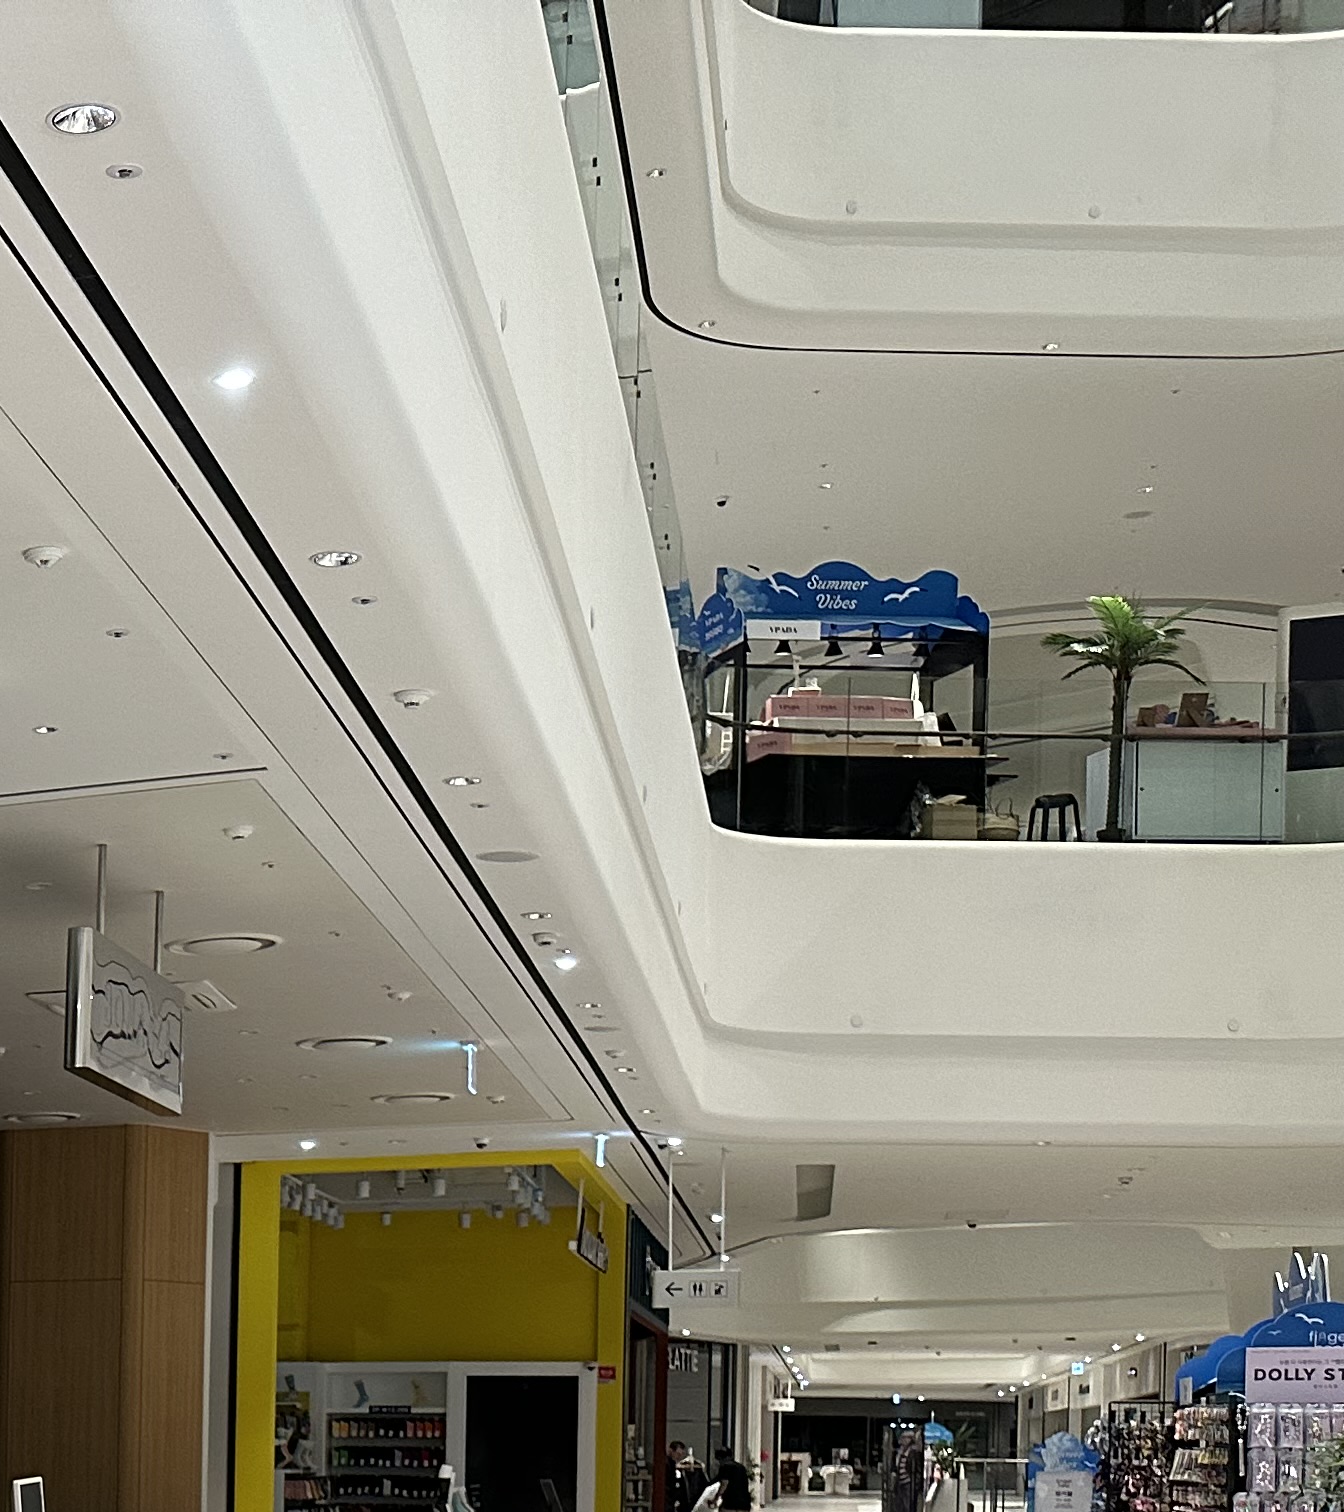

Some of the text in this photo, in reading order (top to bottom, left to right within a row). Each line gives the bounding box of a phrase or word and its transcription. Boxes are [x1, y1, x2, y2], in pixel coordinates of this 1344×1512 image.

[807, 574, 869, 592] Summer
[816, 594, 858, 611] Vibes
[1254, 1368, 1315, 1381] DOLLY
